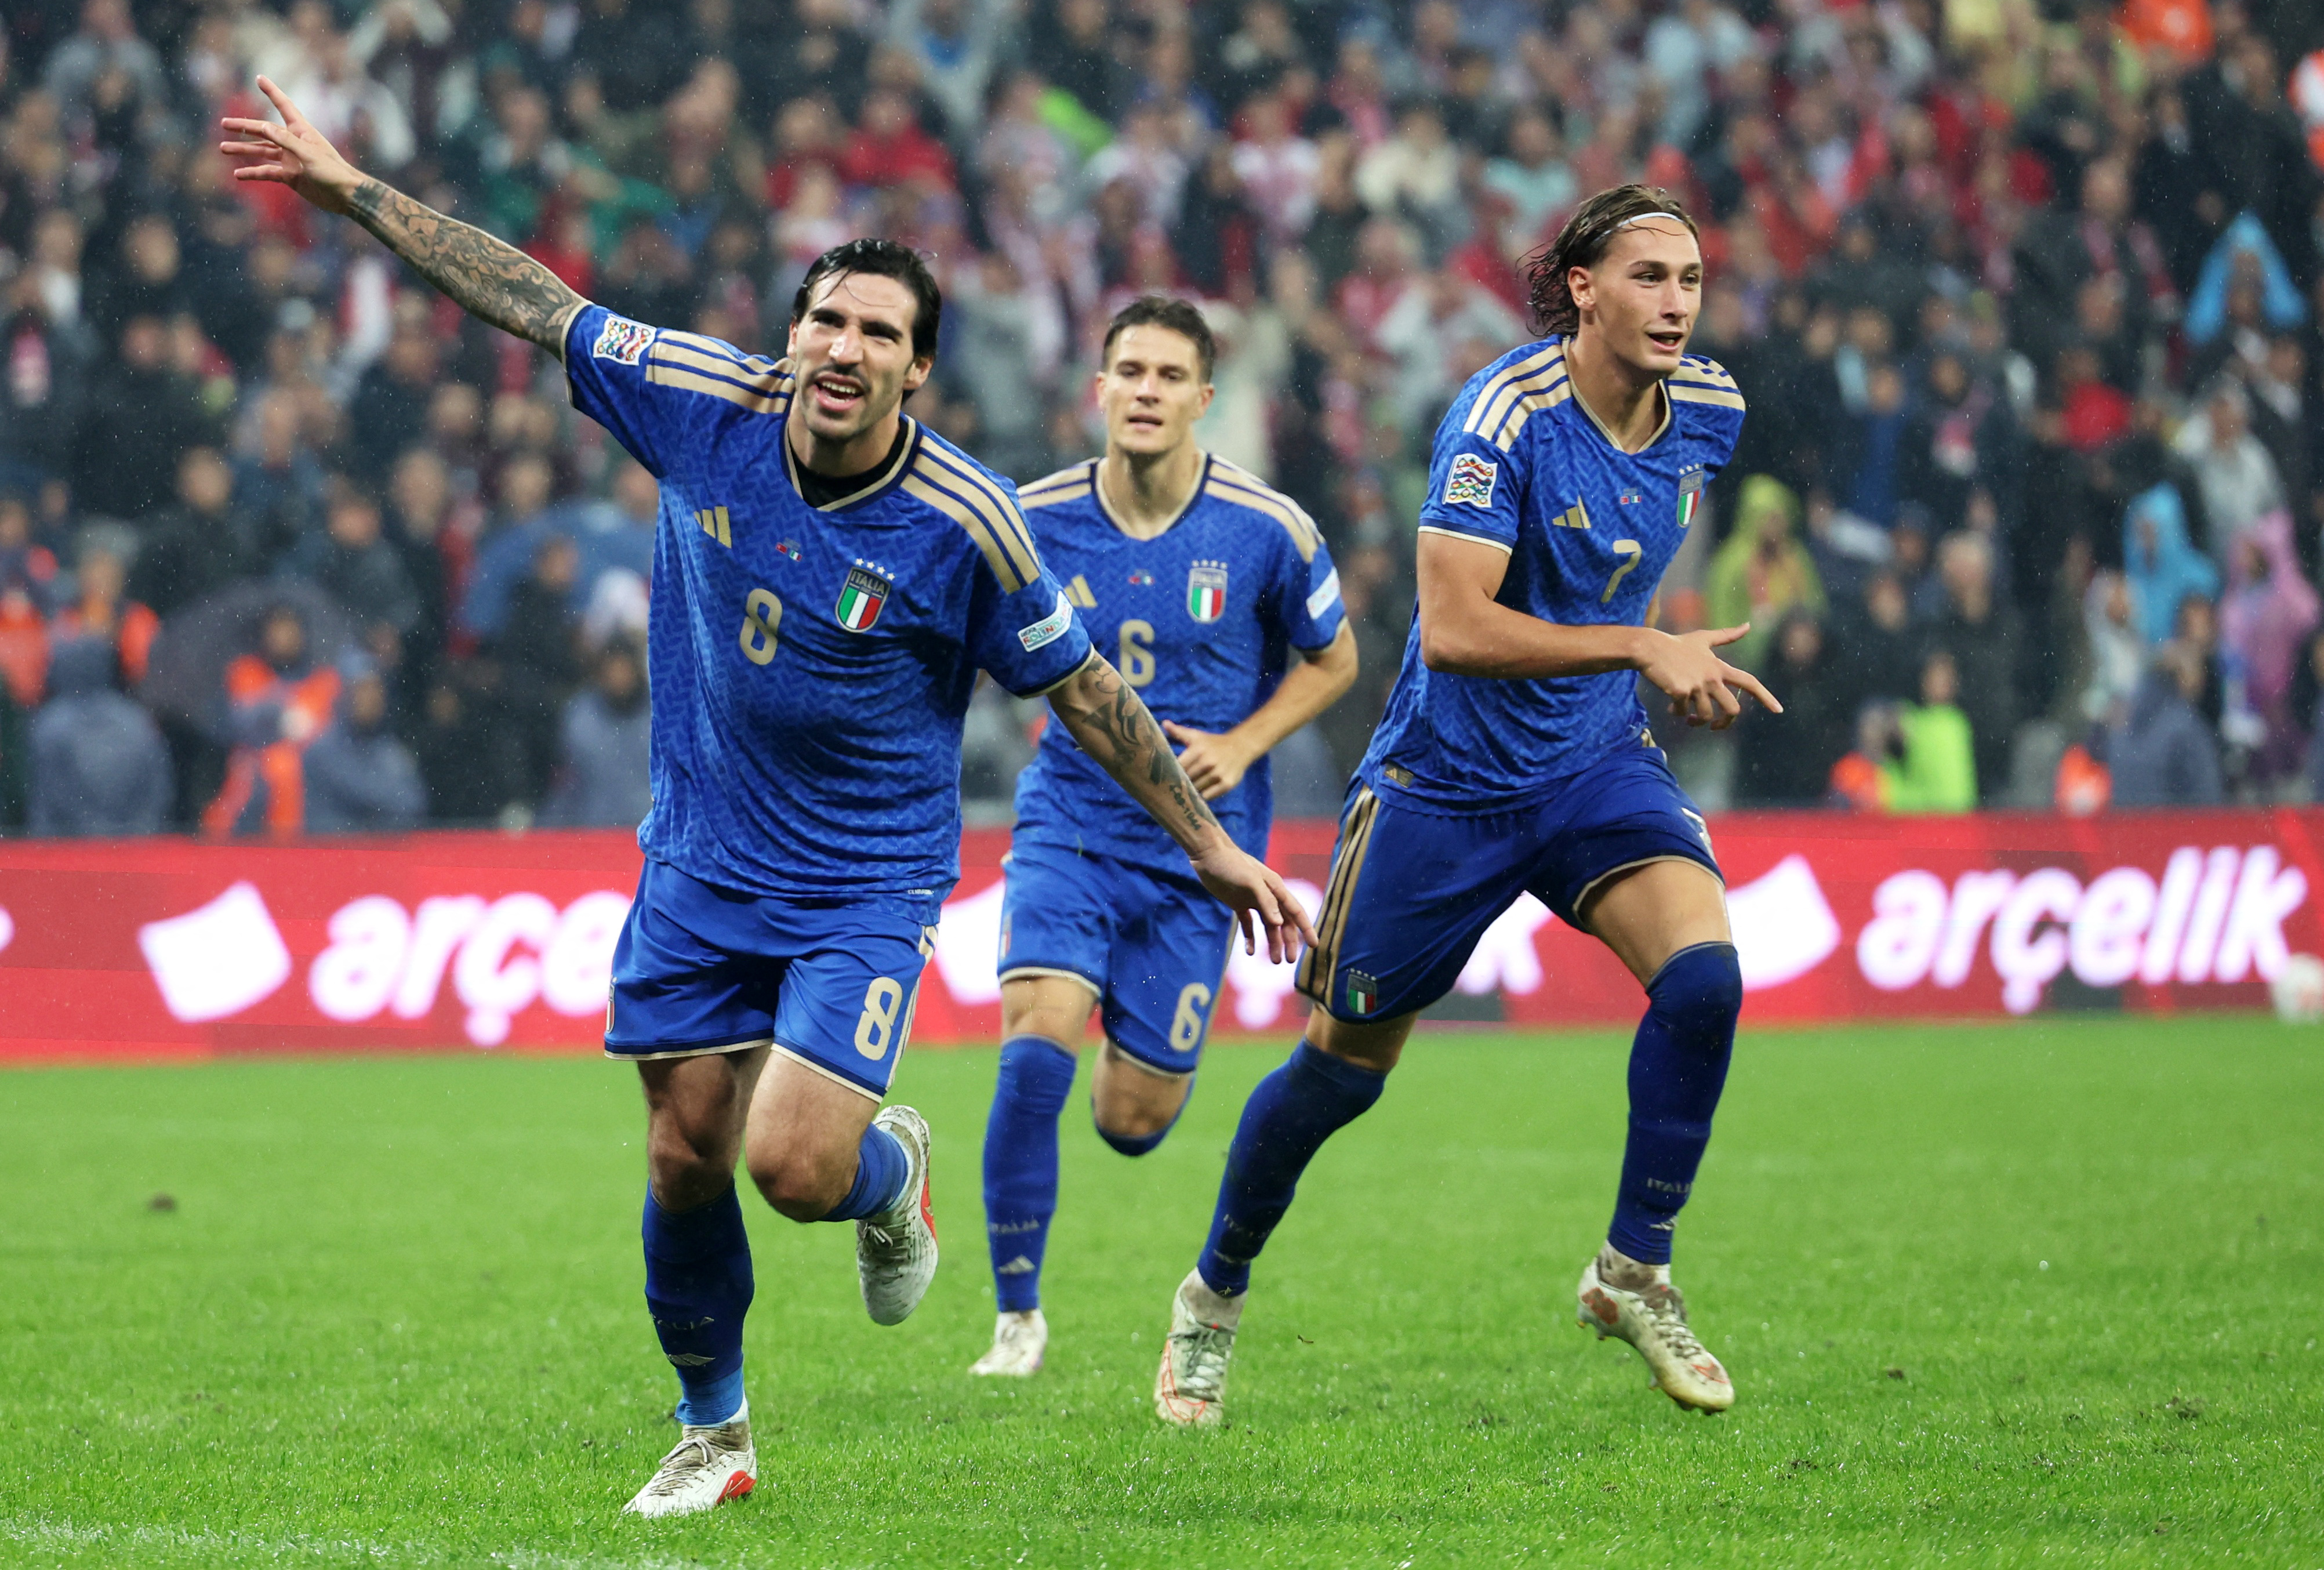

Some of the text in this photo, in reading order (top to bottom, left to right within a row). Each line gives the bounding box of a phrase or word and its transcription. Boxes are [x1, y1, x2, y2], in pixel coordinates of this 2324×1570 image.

[849, 571, 885, 594] ITALIA
[1600, 539, 1642, 603] 7
[739, 588, 783, 666] 8
[1119, 619, 1156, 687] 6
[1857, 844, 2307, 1015] arçelik
[308, 890, 637, 1049] arçe
[854, 977, 903, 1061] 8
[1170, 982, 1211, 1052] 6
